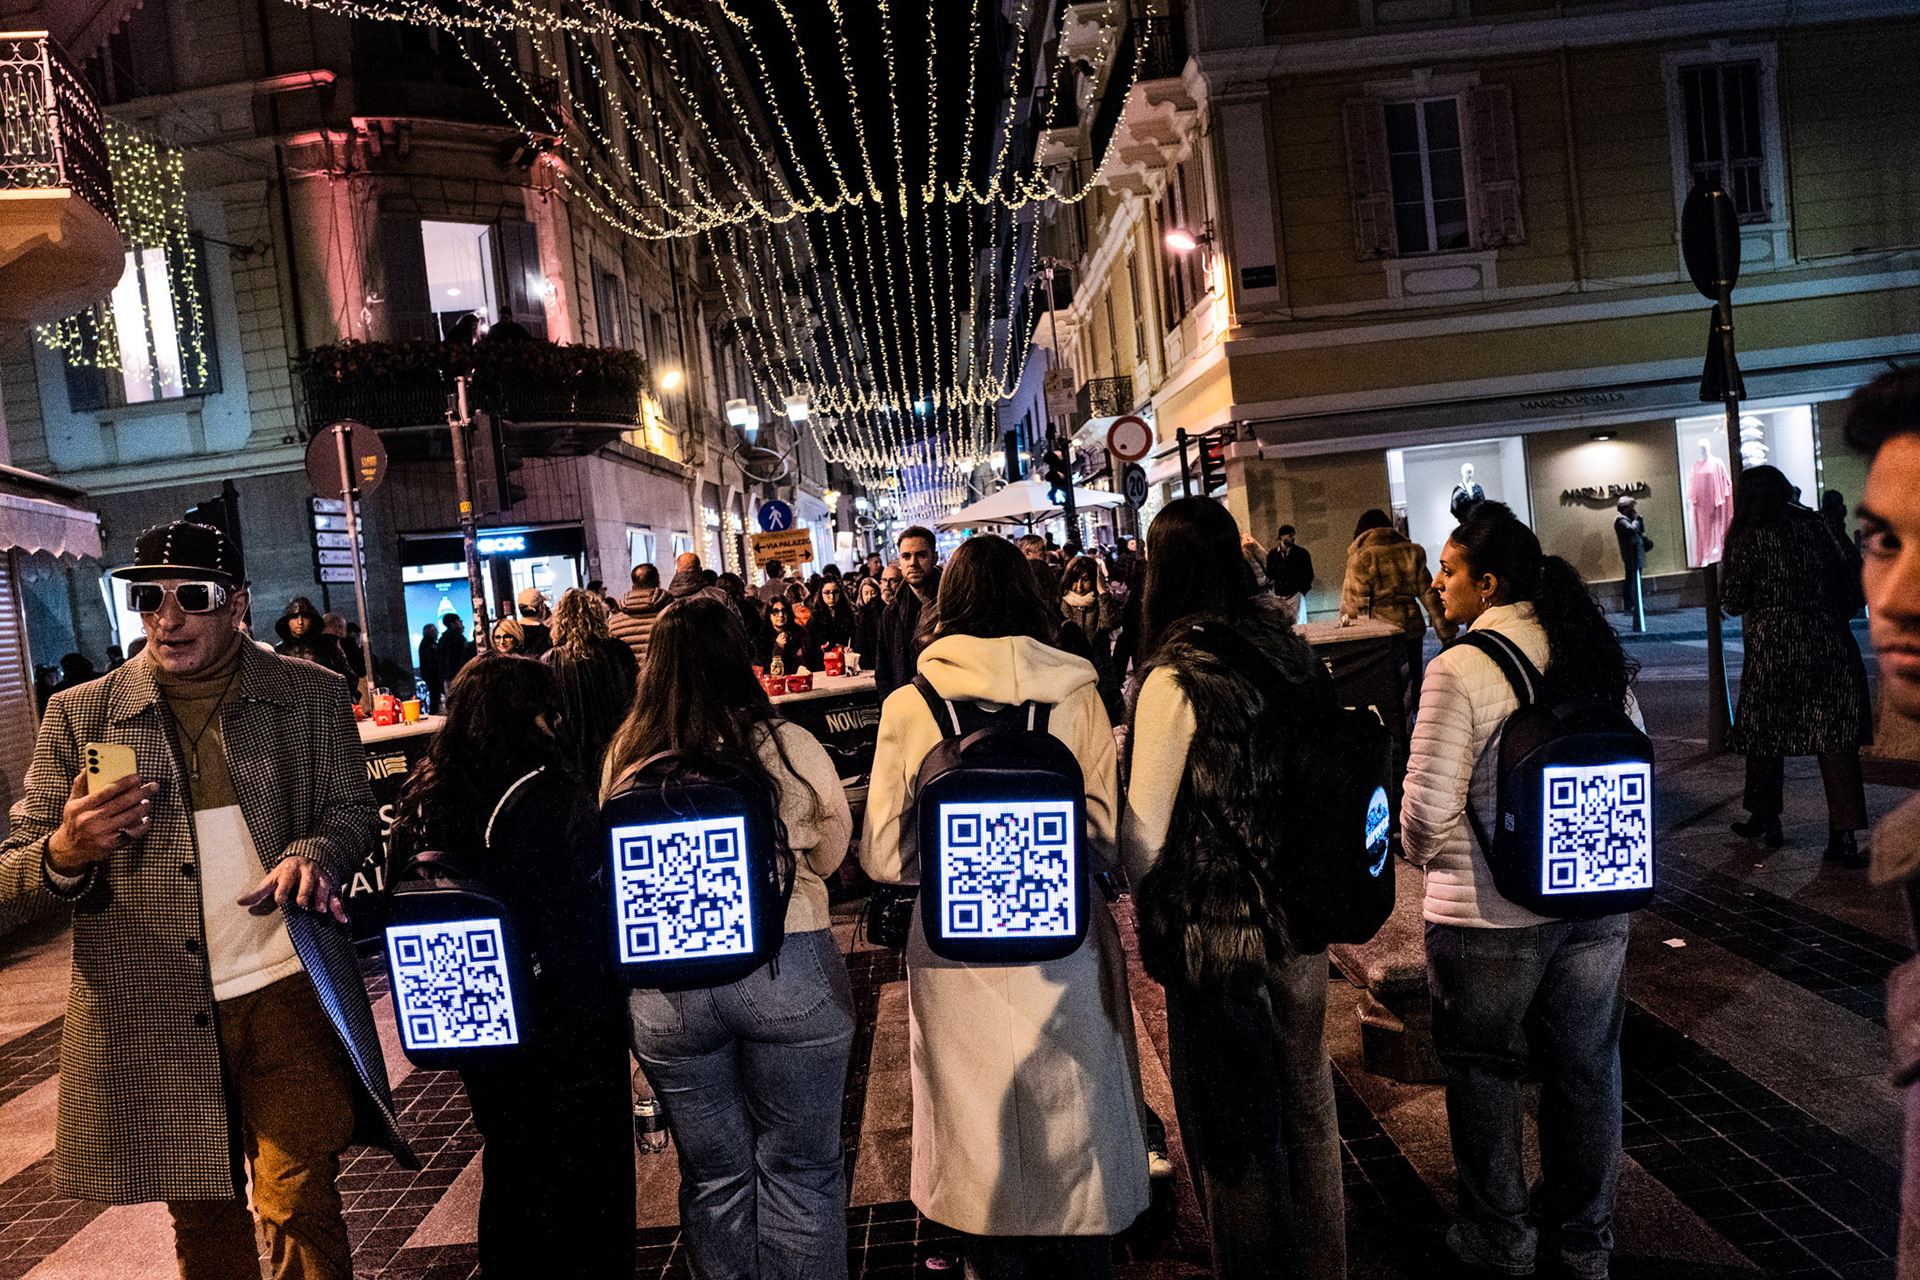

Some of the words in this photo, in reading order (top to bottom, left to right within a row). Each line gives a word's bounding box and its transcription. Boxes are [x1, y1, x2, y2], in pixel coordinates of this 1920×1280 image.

[1129, 476, 1144, 497] 20
[766, 542, 778, 550] VIA
[779, 538, 811, 547] PALAZZO
